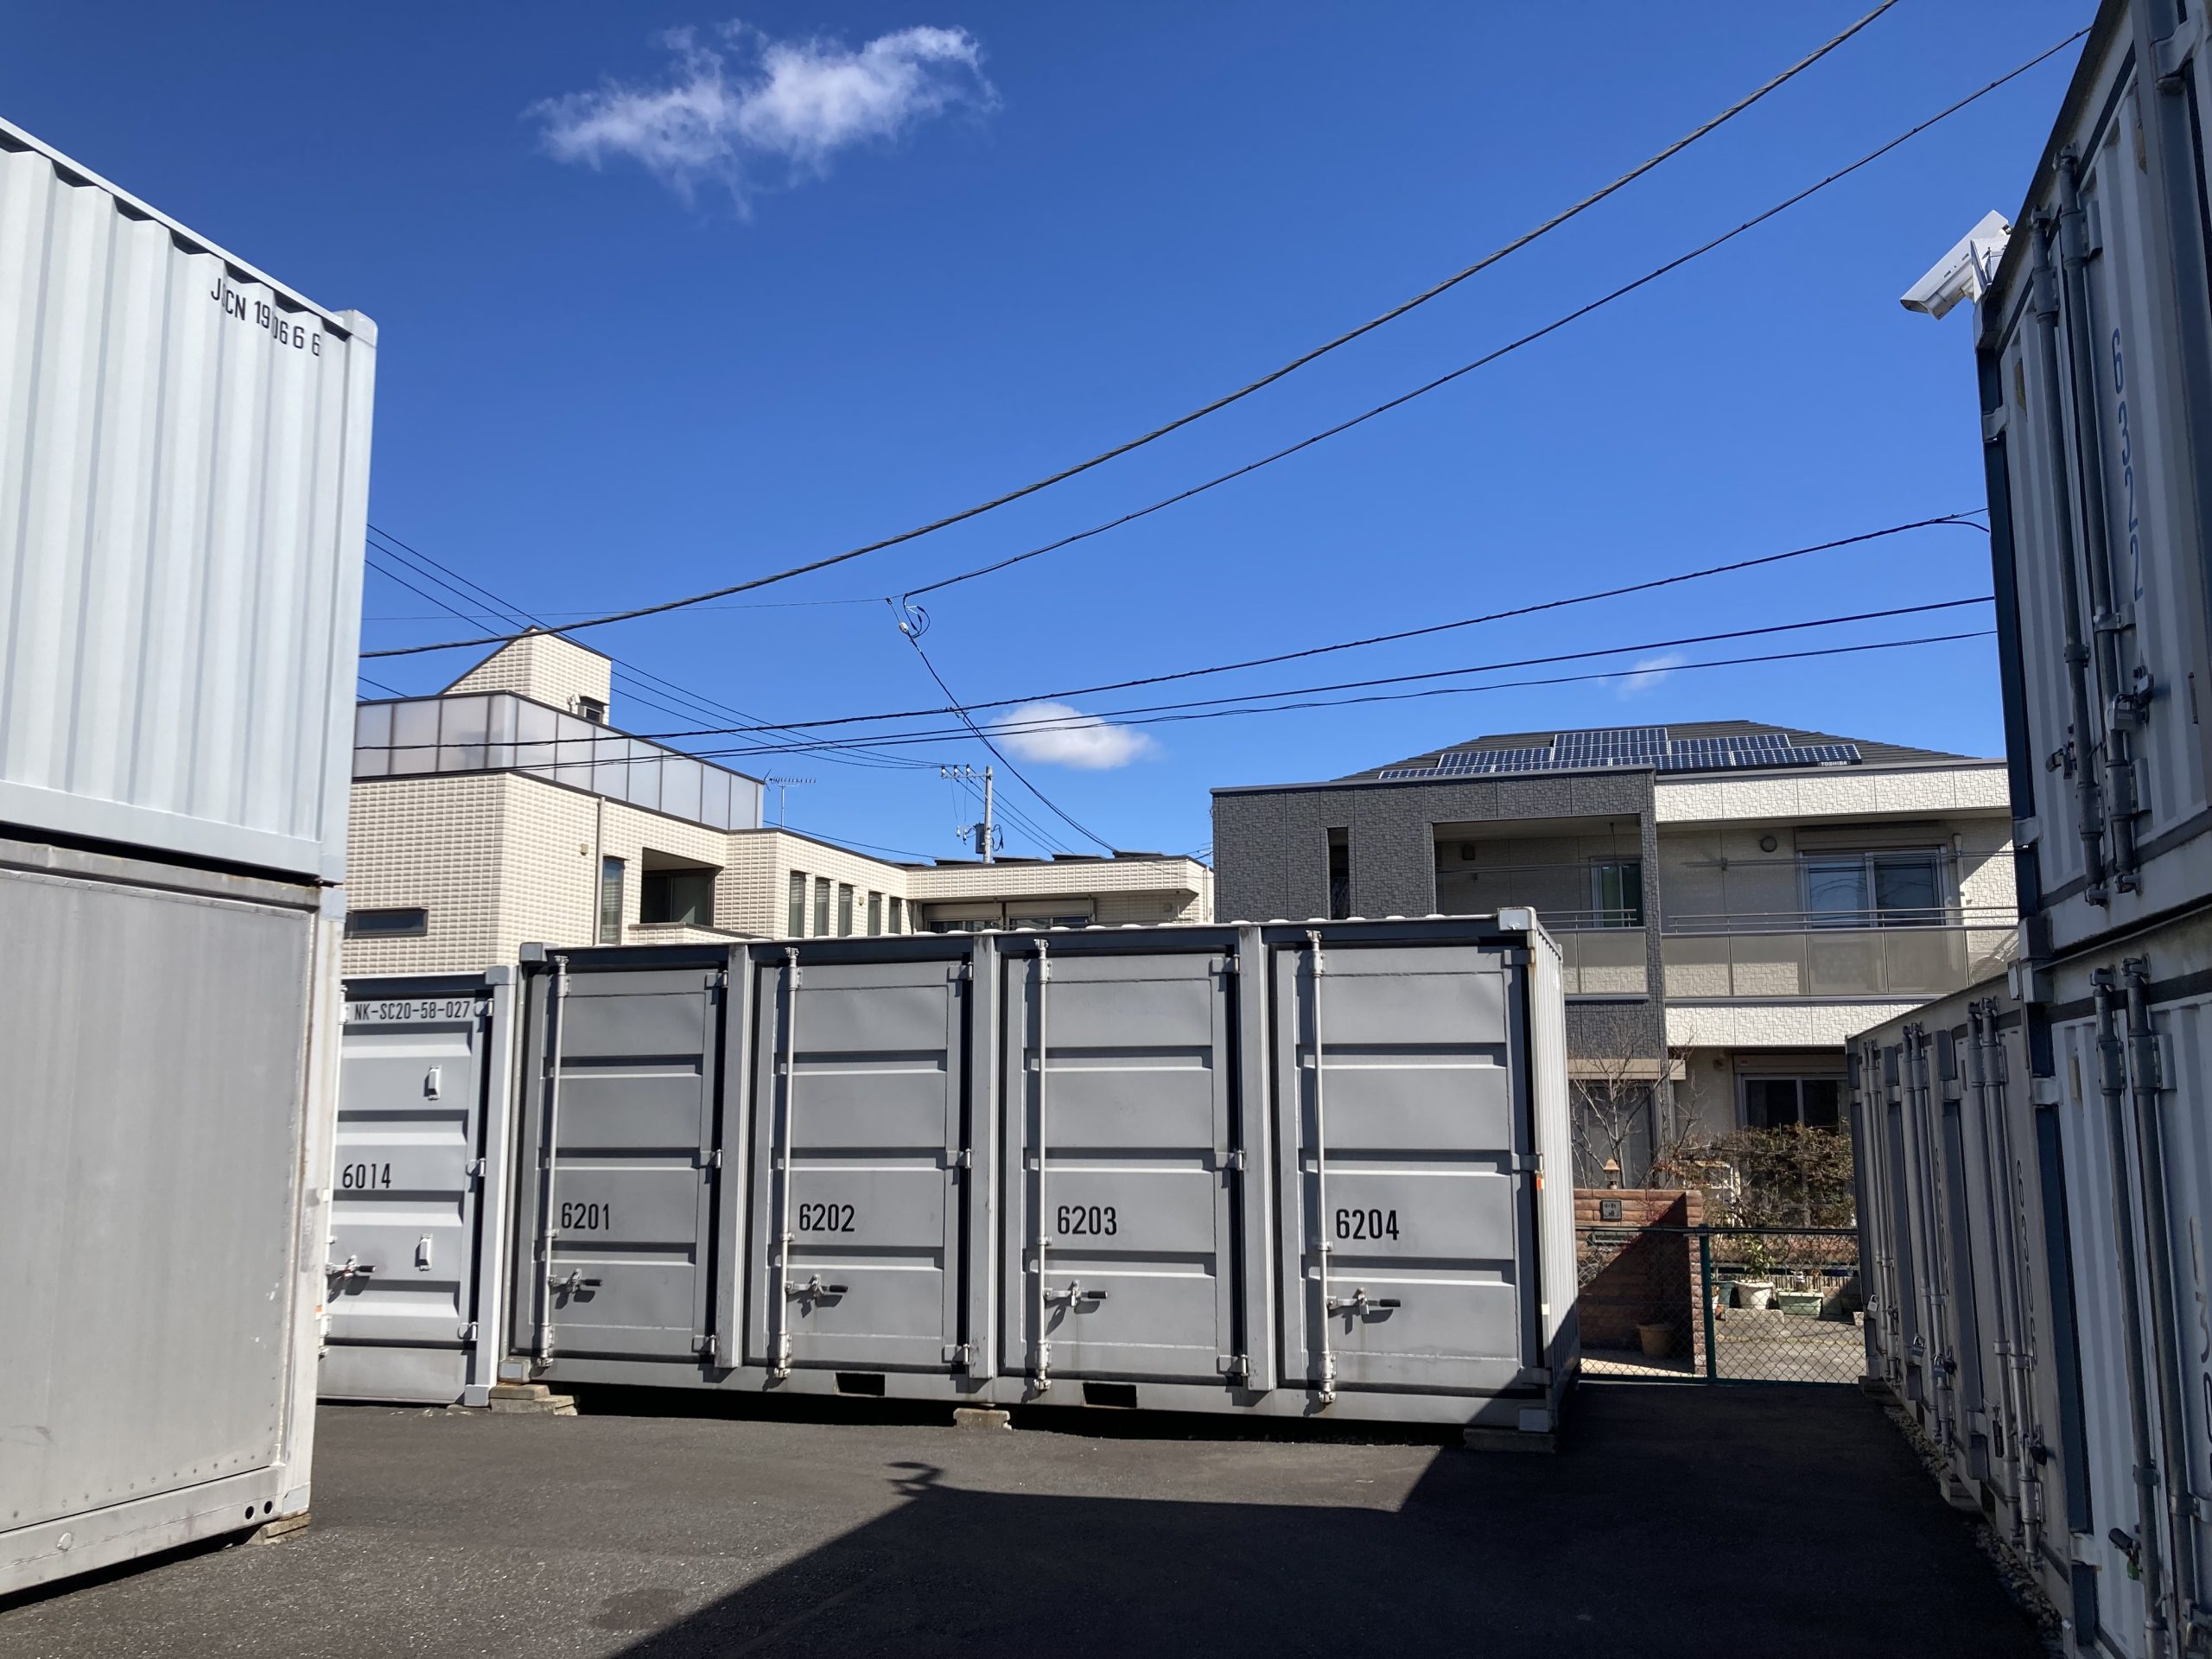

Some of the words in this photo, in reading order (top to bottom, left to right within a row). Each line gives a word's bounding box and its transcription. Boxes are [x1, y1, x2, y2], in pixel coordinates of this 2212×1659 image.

[2111, 327, 2144, 602] 6322
[342, 1163, 391, 1189] 6014
[561, 1202, 609, 1230] 6201
[798, 1203, 855, 1233] 6202
[1056, 1205, 1117, 1236] 6203
[1335, 1208, 1400, 1241] 6204
